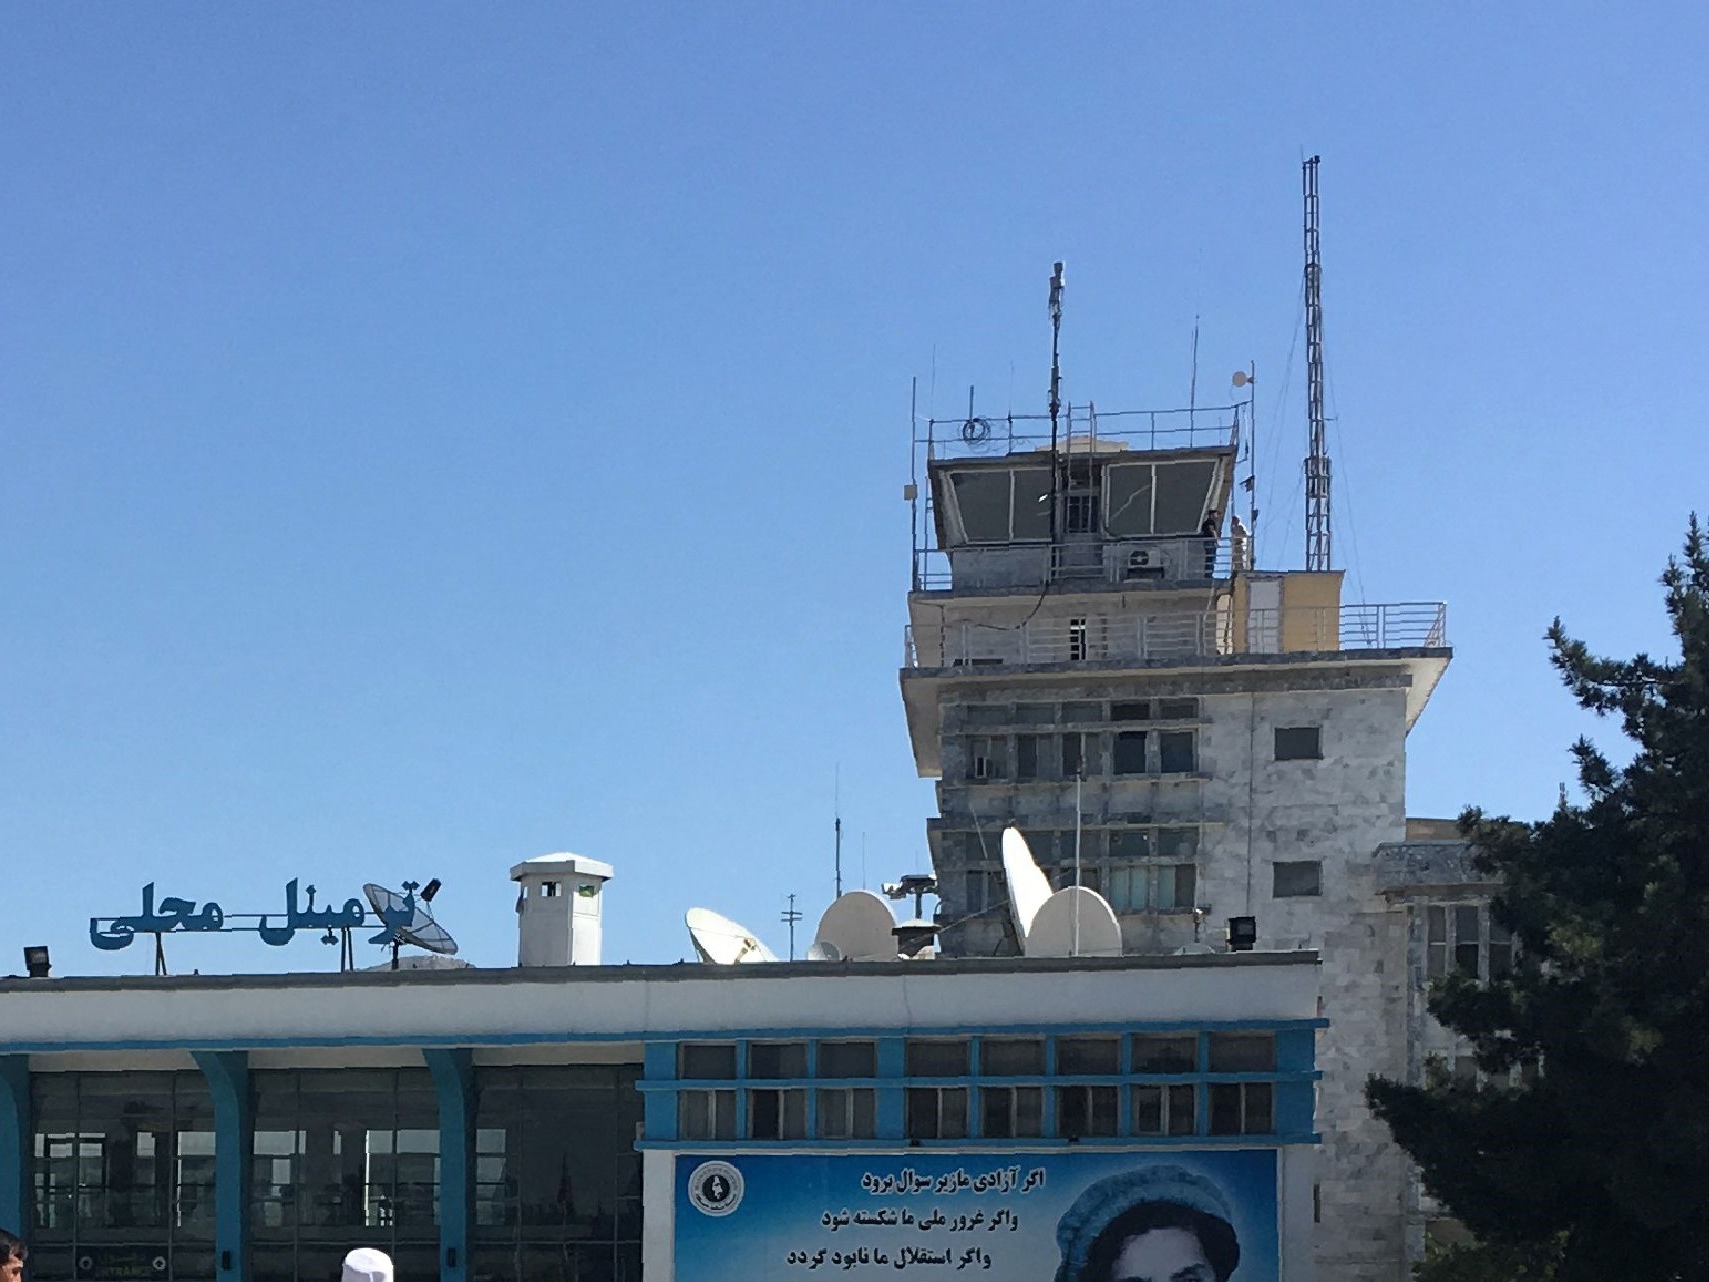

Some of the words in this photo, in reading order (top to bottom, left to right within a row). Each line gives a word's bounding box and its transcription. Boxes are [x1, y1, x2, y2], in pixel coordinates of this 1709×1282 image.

[90, 881, 224, 950] محلی
[901, 1209, 915, 1225] ما
[873, 1247, 889, 1264] ما
